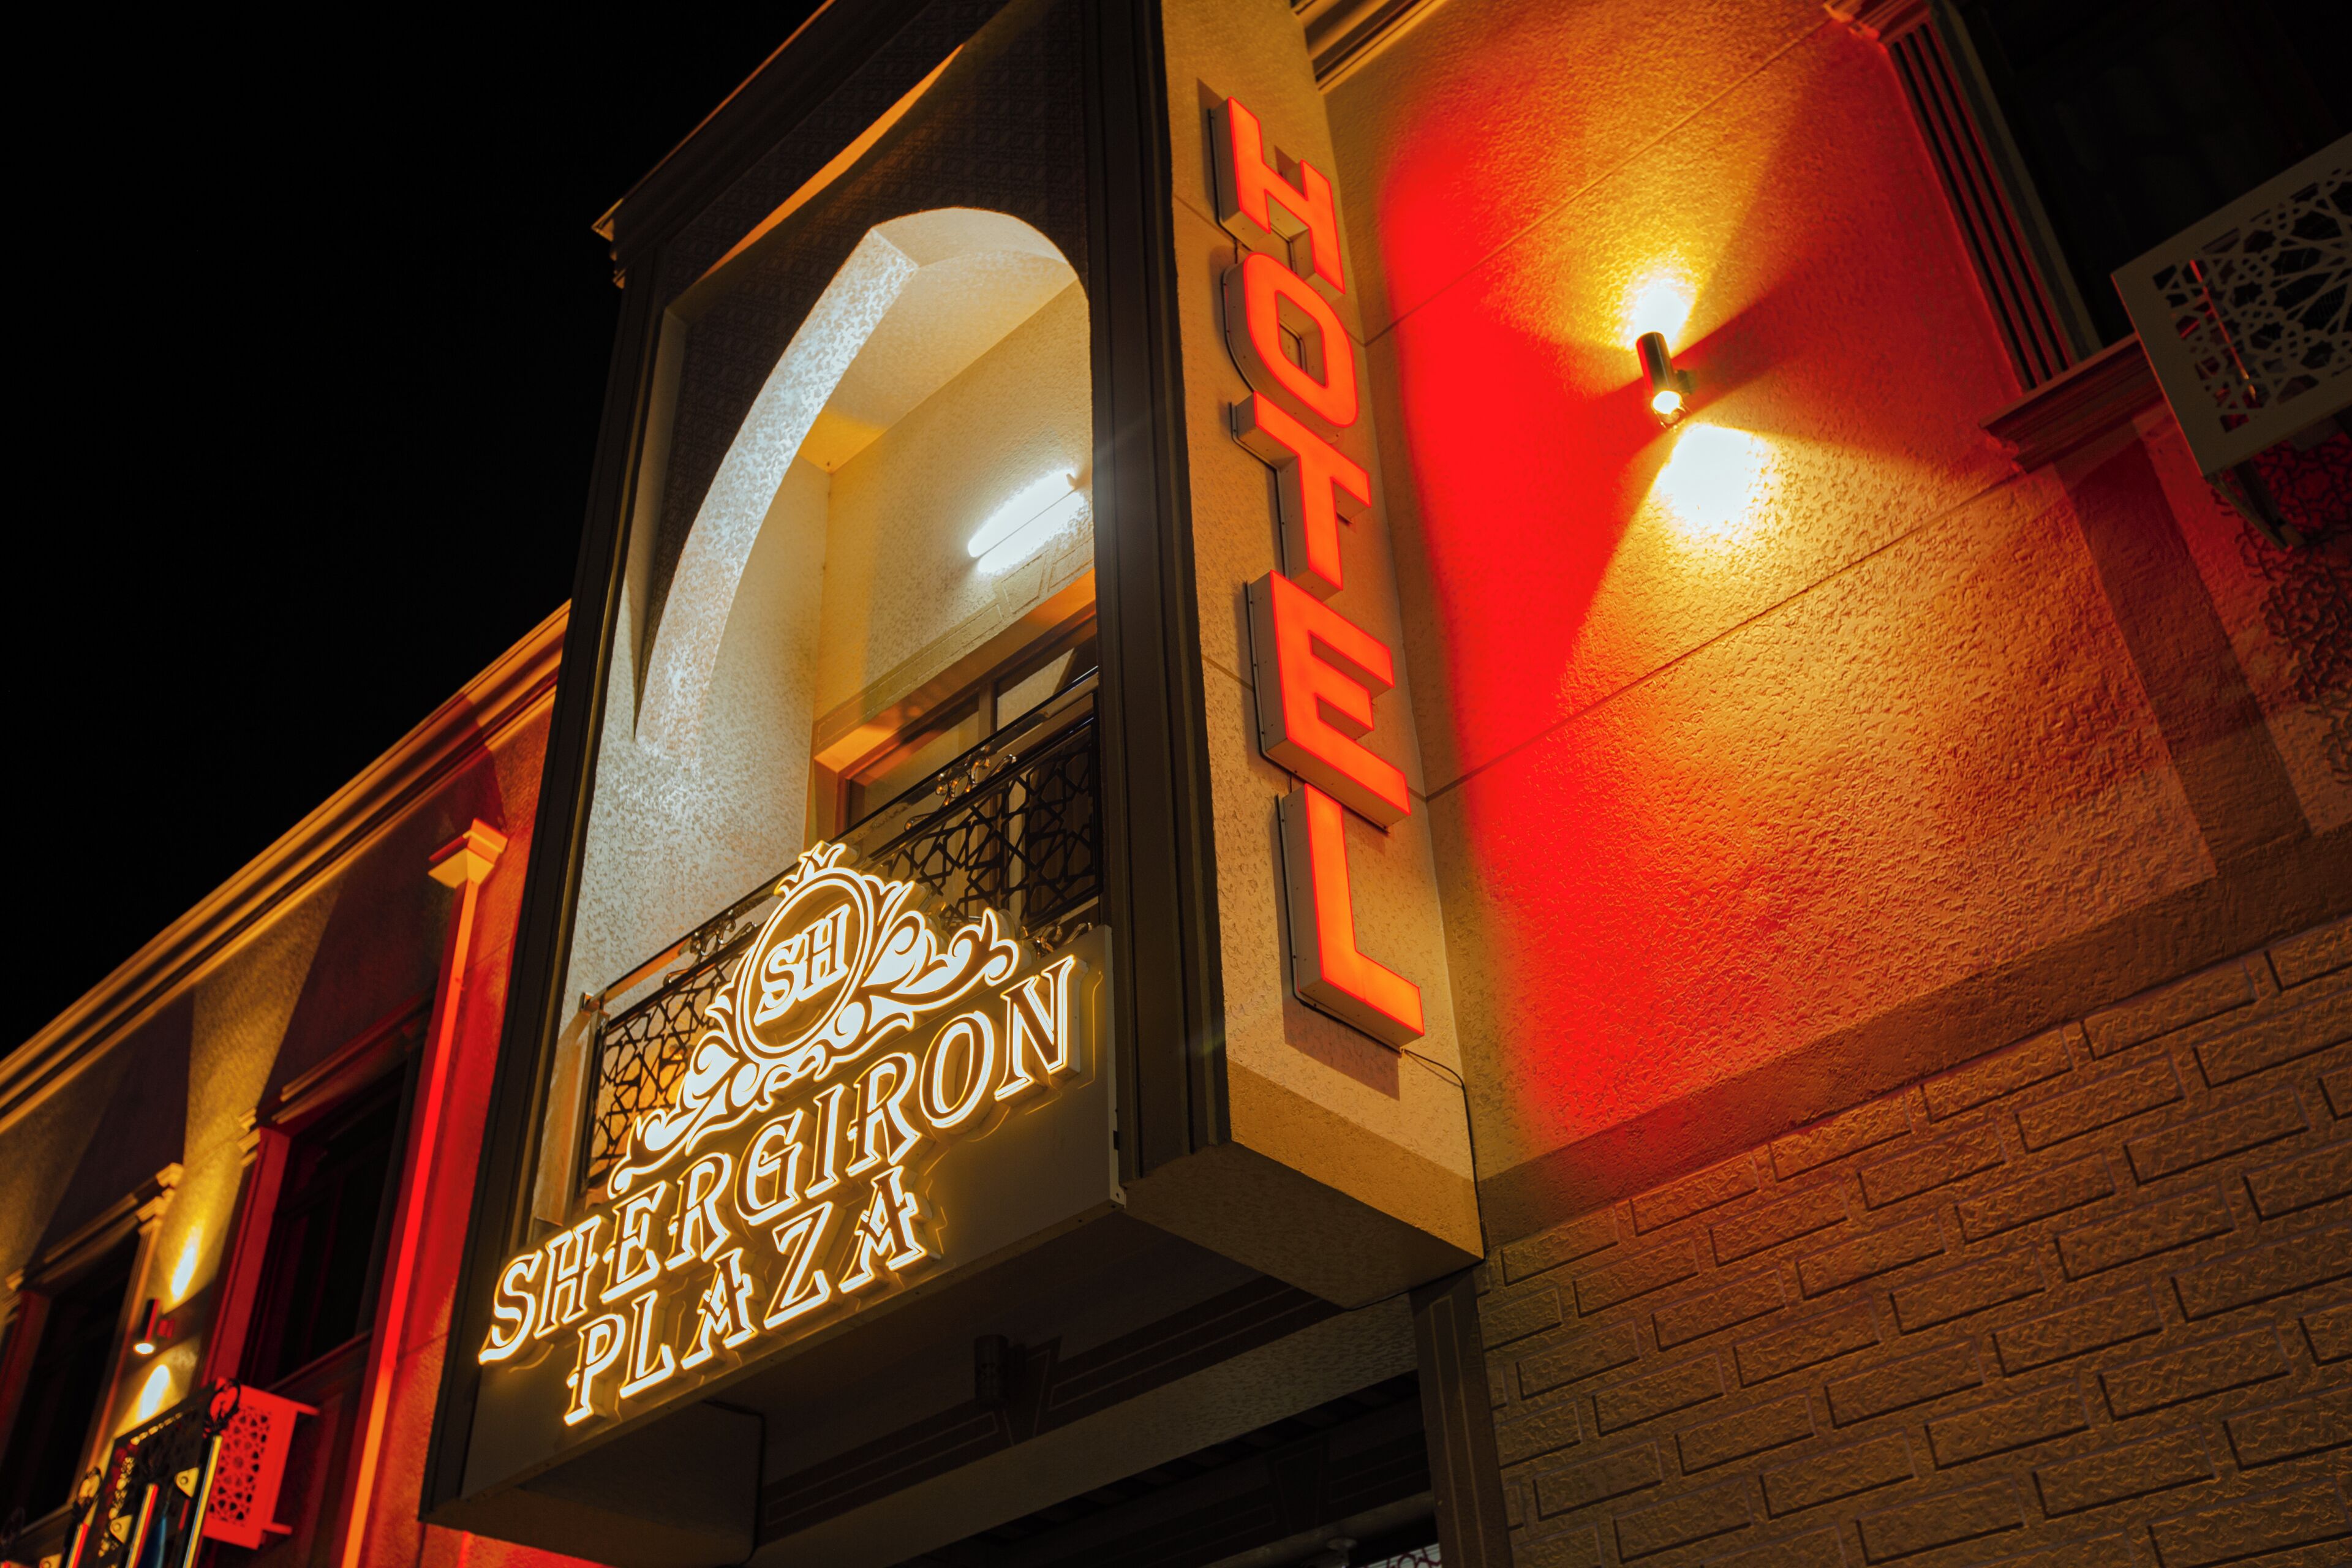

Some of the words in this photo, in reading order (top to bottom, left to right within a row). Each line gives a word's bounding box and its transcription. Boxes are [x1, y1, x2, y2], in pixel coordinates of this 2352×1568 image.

[1228, 96, 1425, 1036] HOTEL
[754, 904, 849, 1026] SH
[479, 955, 1076, 1363] SHERGIRON
[564, 1165, 927, 1426] PLAZA
